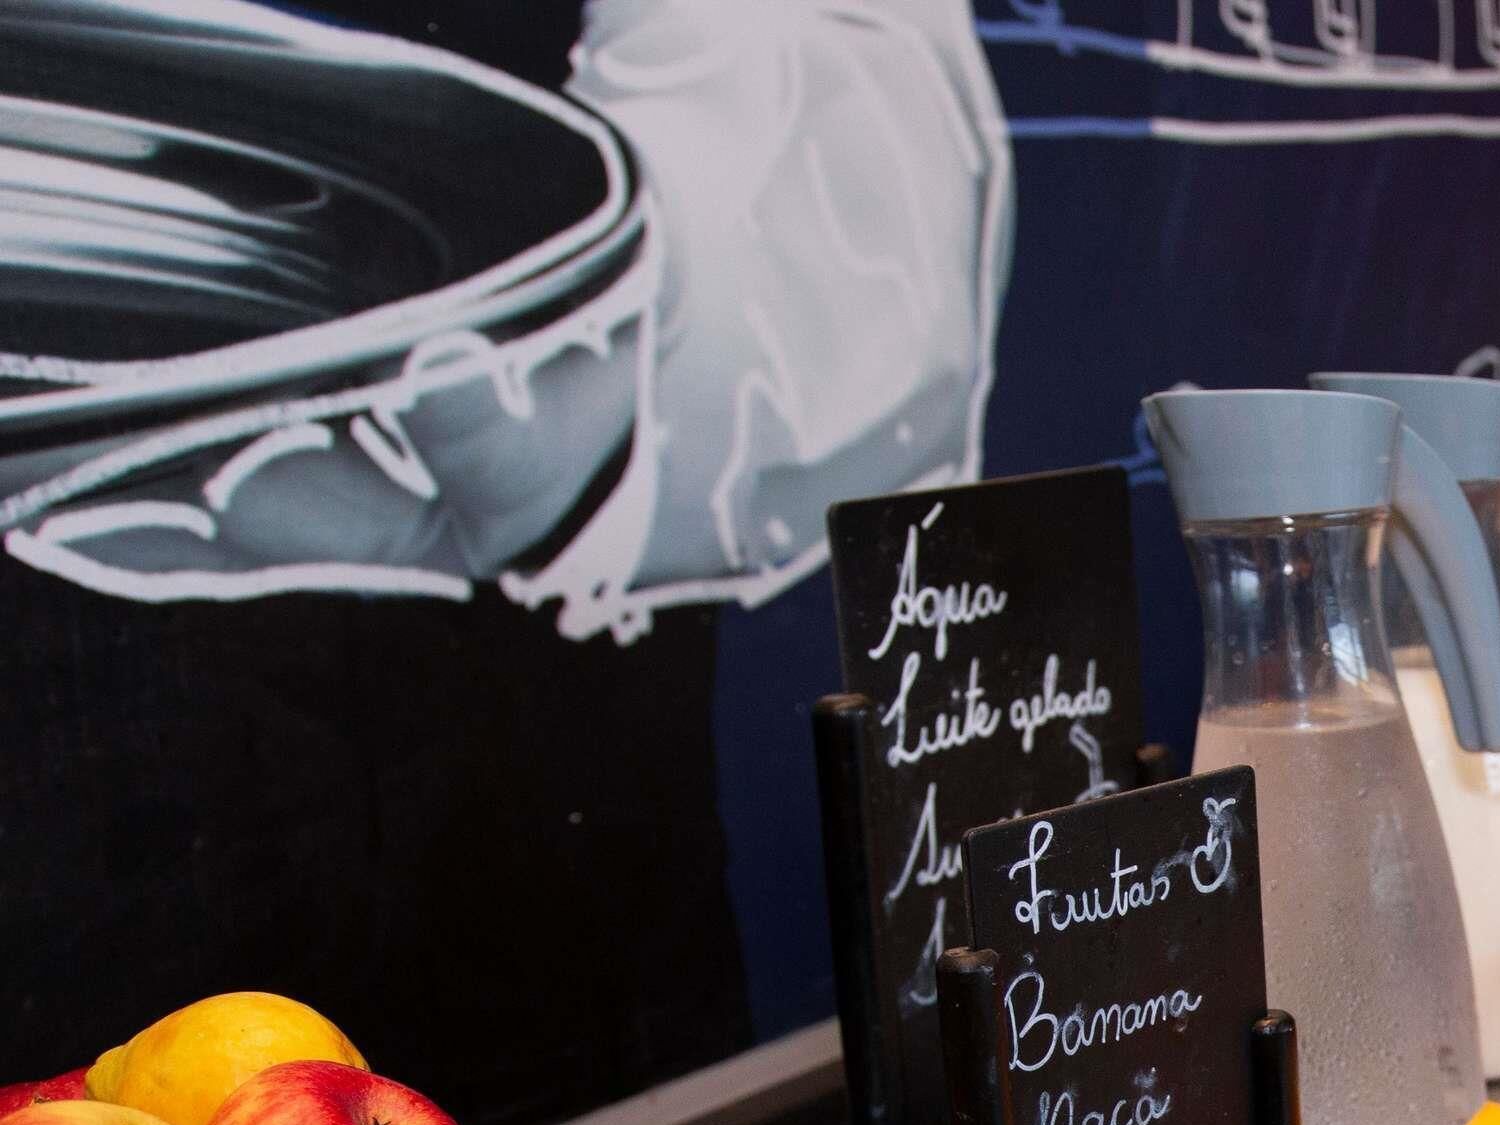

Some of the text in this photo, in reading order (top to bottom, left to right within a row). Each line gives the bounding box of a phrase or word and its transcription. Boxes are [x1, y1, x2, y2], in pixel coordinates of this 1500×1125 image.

[869, 501, 1007, 661] Água
[882, 650, 1112, 768] Leite gelado
[1008, 819, 1170, 935] Frutas
[1004, 970, 1203, 1071] Banana
